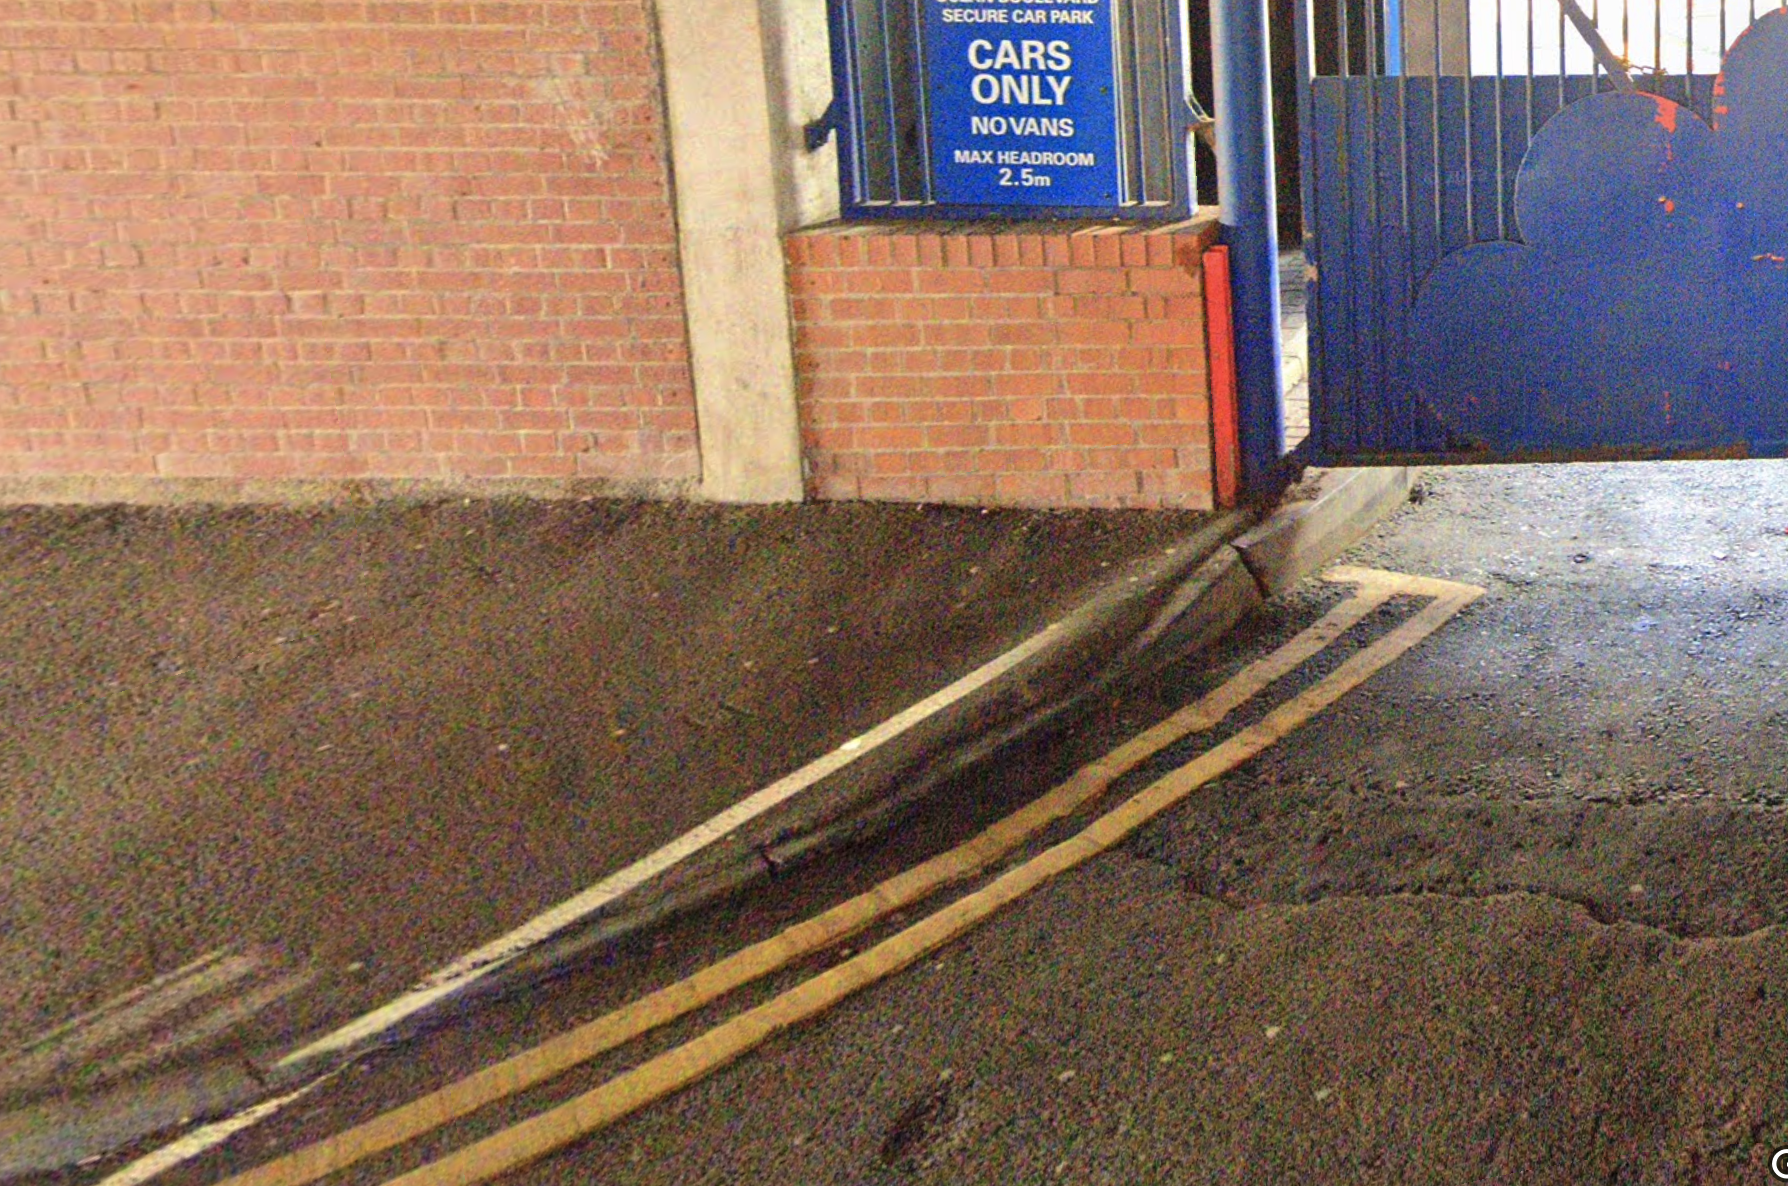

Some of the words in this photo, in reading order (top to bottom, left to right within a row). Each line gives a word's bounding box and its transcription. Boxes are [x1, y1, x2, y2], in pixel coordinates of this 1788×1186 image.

[942, 9, 1008, 23] SECURE
[1012, 9, 1046, 23] CAR
[1050, 9, 1094, 24] PARK
[967, 39, 1072, 70] CARS
[970, 75, 1072, 105] ONLY
[971, 116, 1007, 135] NO
[1009, 117, 1075, 137] VANS
[954, 150, 993, 164] MAX
[997, 151, 1095, 166] HEADROOM
[1000, 168, 1051, 187] 2.5m
